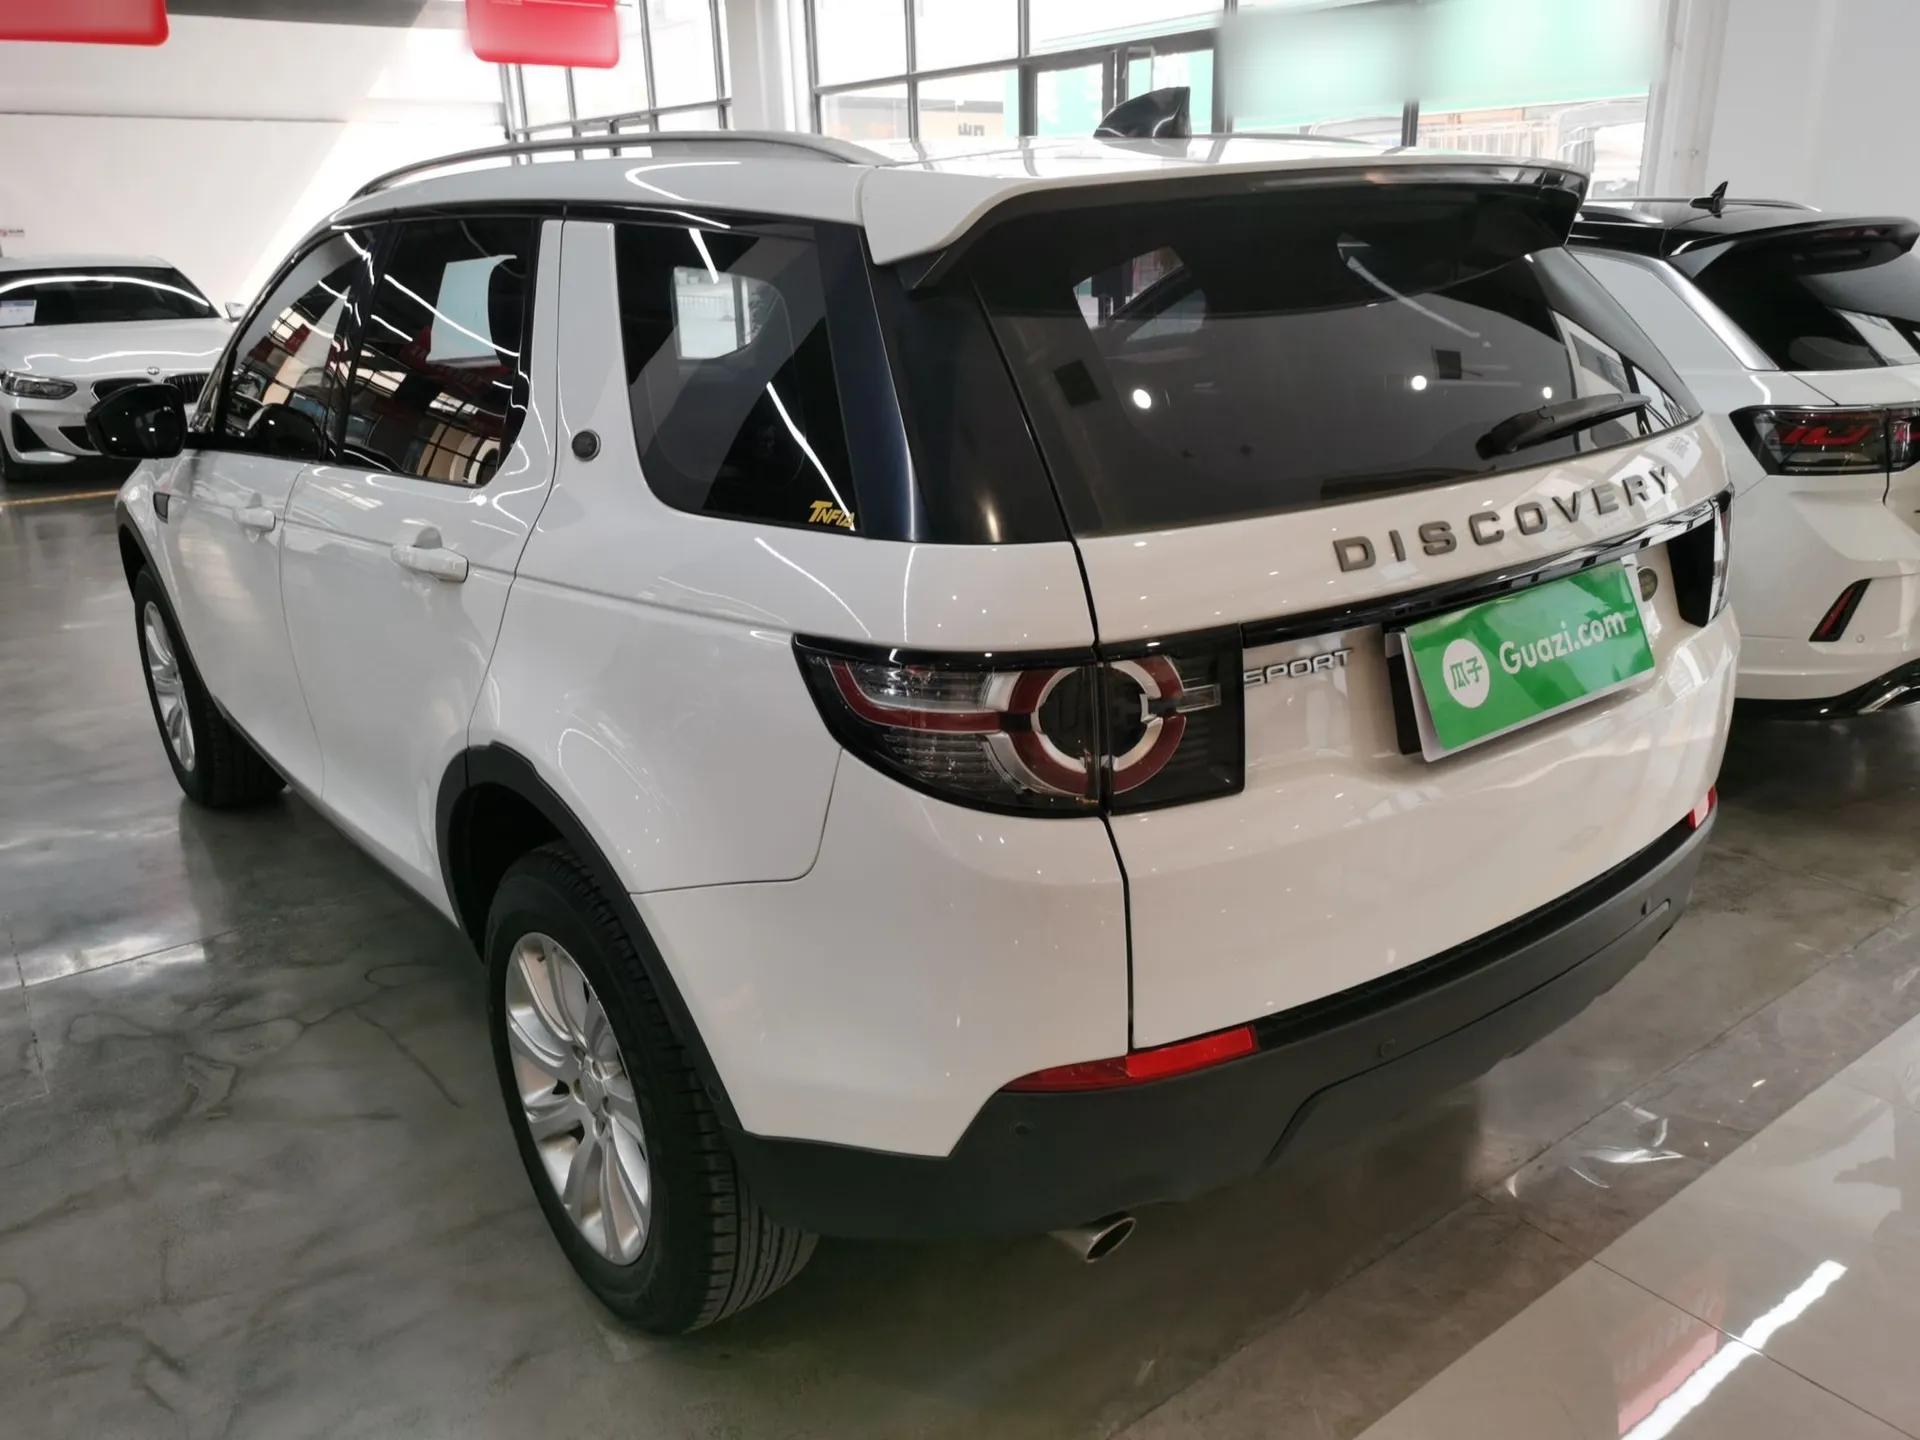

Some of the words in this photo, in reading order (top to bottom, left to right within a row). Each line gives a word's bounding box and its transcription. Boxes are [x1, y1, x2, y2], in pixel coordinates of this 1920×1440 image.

[1333, 465, 1671, 572] DISCOVERY
[1243, 648, 1354, 689] SPORT
[1499, 611, 1628, 675] Guazi.com
[1450, 656, 1483, 691] 瓜子
